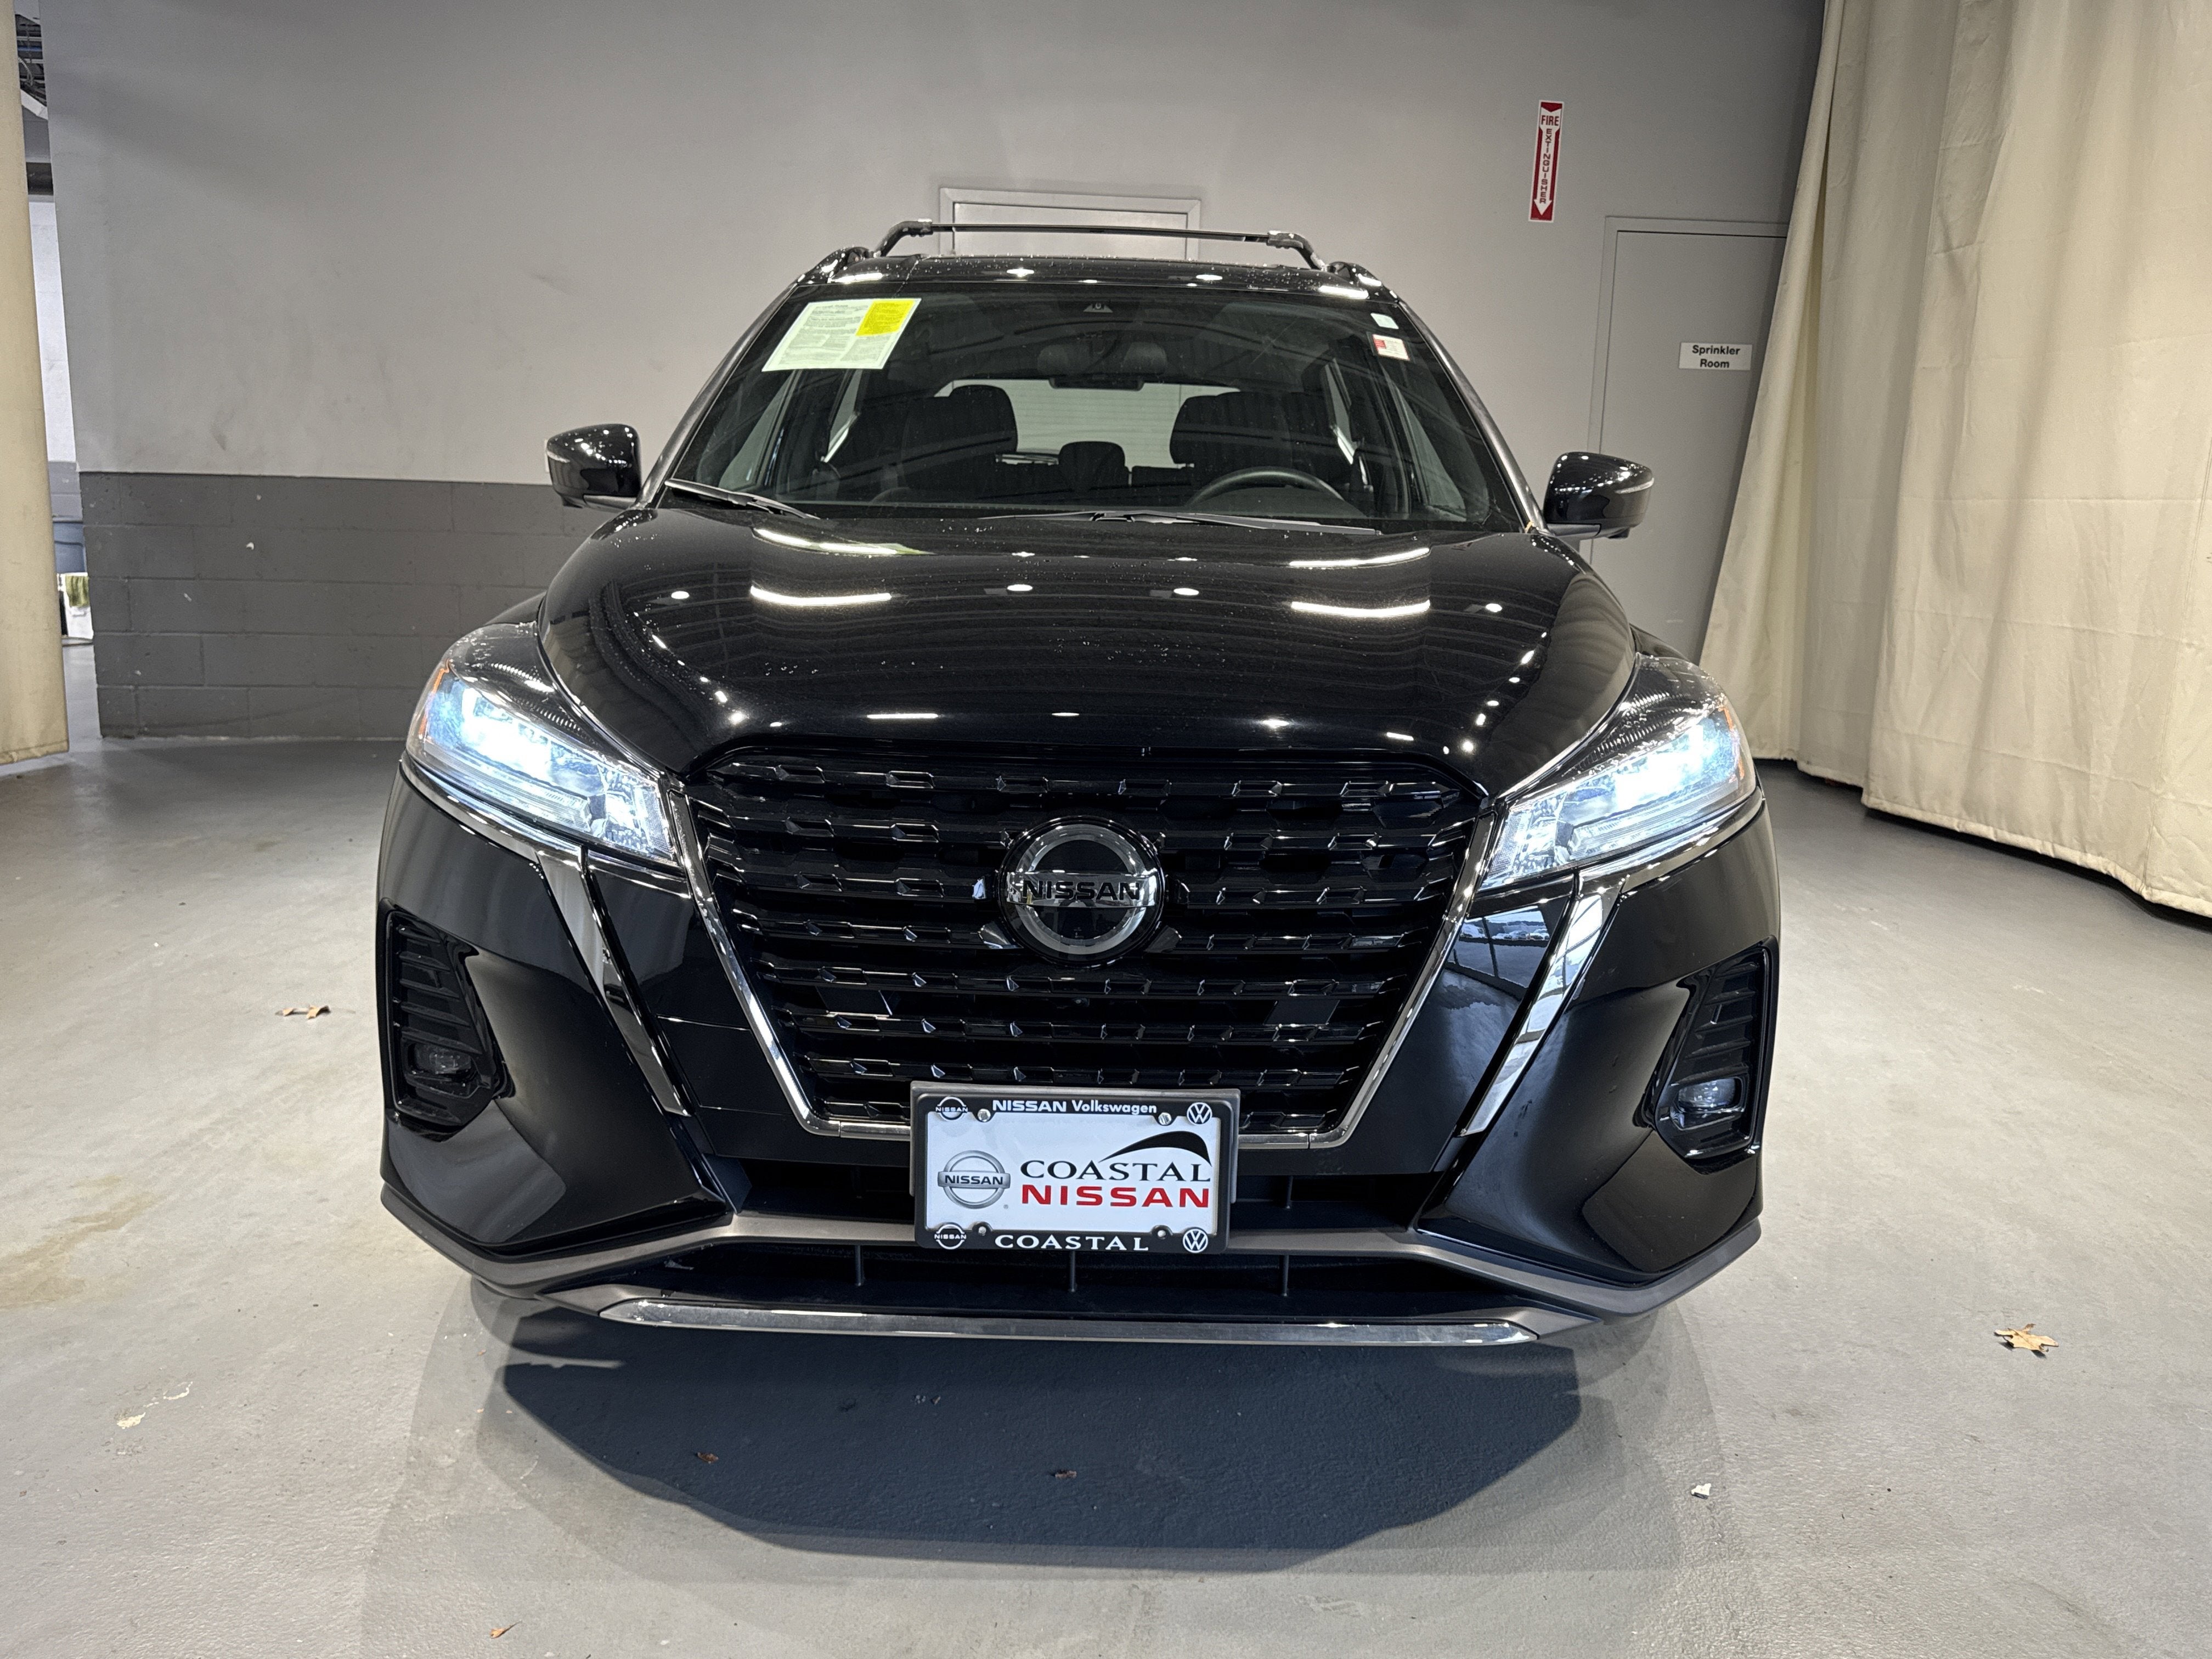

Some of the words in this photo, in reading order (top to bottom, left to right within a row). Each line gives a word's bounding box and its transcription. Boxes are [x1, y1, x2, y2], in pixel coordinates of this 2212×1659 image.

[1541, 115, 1559, 126] FIRE
[1539, 128, 1552, 204] EXTINGUISHER
[1692, 345, 1741, 356] Sprinkler
[1700, 358, 1730, 368] Room
[1022, 880, 1139, 901] NISSAN
[992, 1099, 1066, 1113] NISSAN
[1072, 1100, 1157, 1115] Volkswagen
[1020, 1160, 1211, 1182] COASTAL
[945, 1175, 1003, 1185] NISSAN
[1022, 1184, 1209, 1208] NISSAN
[995, 1234, 1149, 1251] COASTAL
